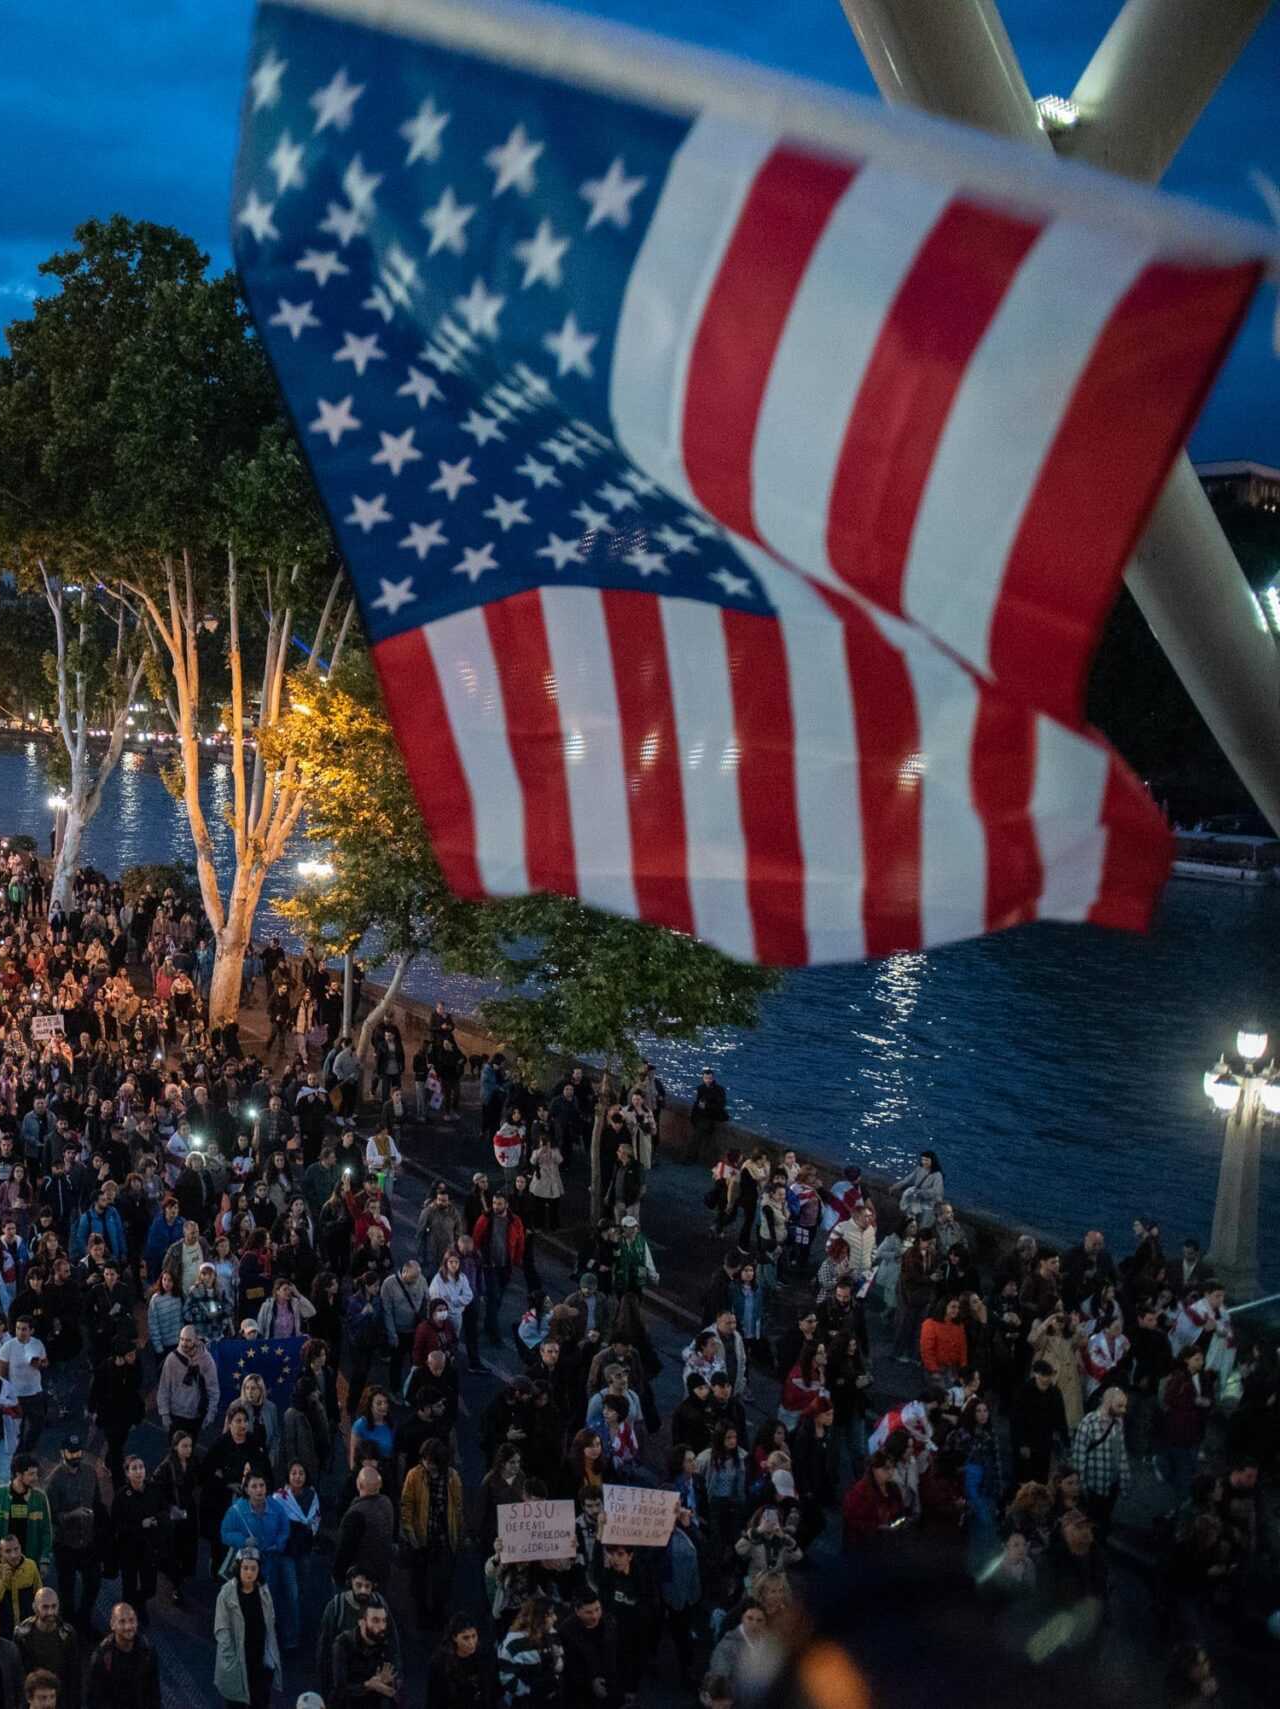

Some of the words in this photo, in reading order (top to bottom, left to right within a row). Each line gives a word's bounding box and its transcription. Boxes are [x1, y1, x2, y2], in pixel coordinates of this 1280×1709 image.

[608, 1488, 666, 1505] AZTECS
[611, 1503, 625, 1512] FOR
[506, 1520, 545, 1532] DEFEND
[531, 1530, 571, 1539] FREEDOM
[521, 1542, 559, 1553] GEORGIA
